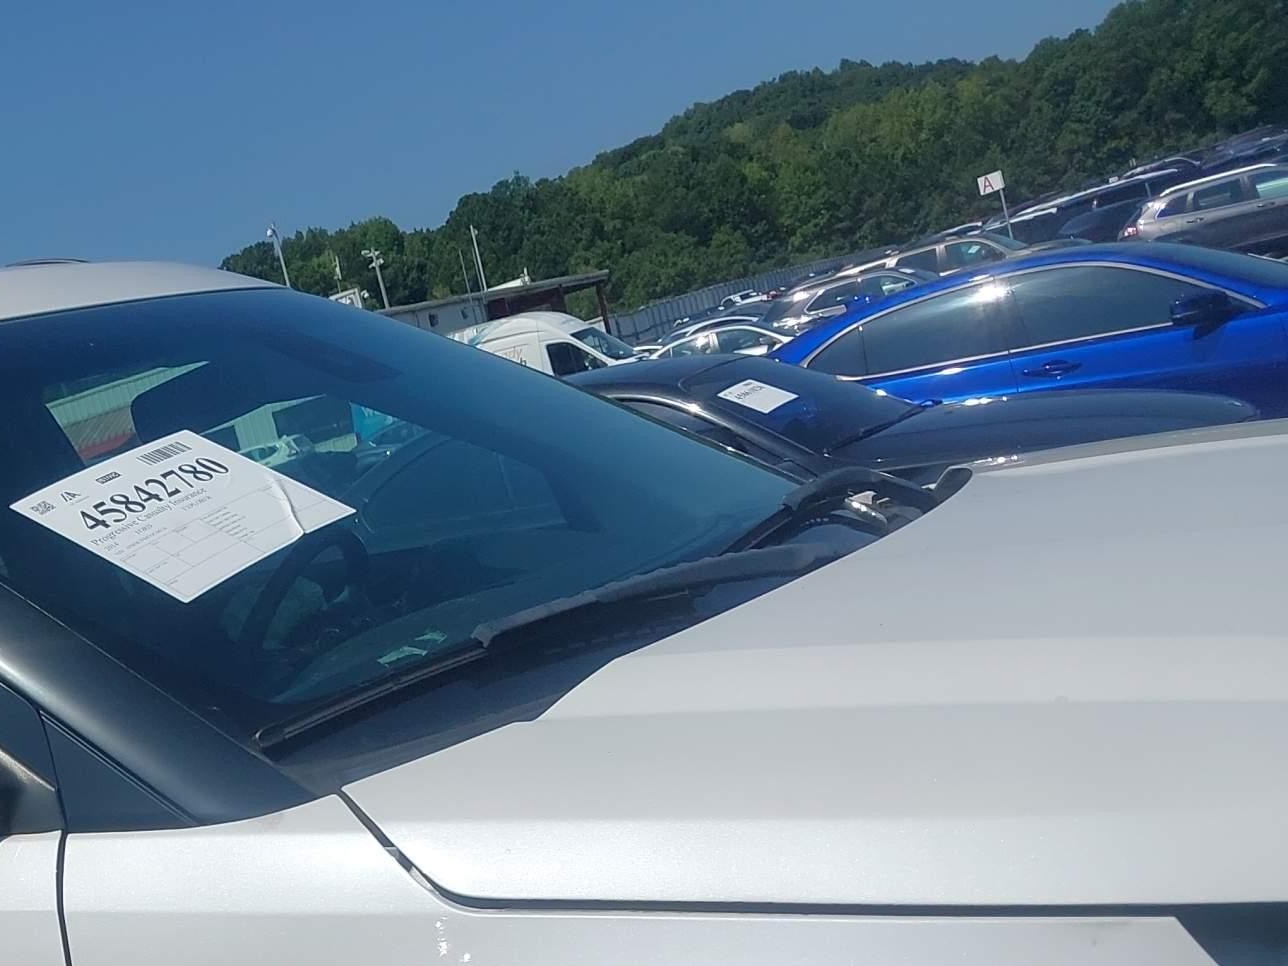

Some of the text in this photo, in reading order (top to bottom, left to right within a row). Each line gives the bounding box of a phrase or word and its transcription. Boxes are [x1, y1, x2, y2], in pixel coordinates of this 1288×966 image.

[983, 176, 994, 193] A
[78, 457, 229, 531] 45842780
[91, 520, 139, 546] Progressive
[137, 502, 173, 522] Casualty
